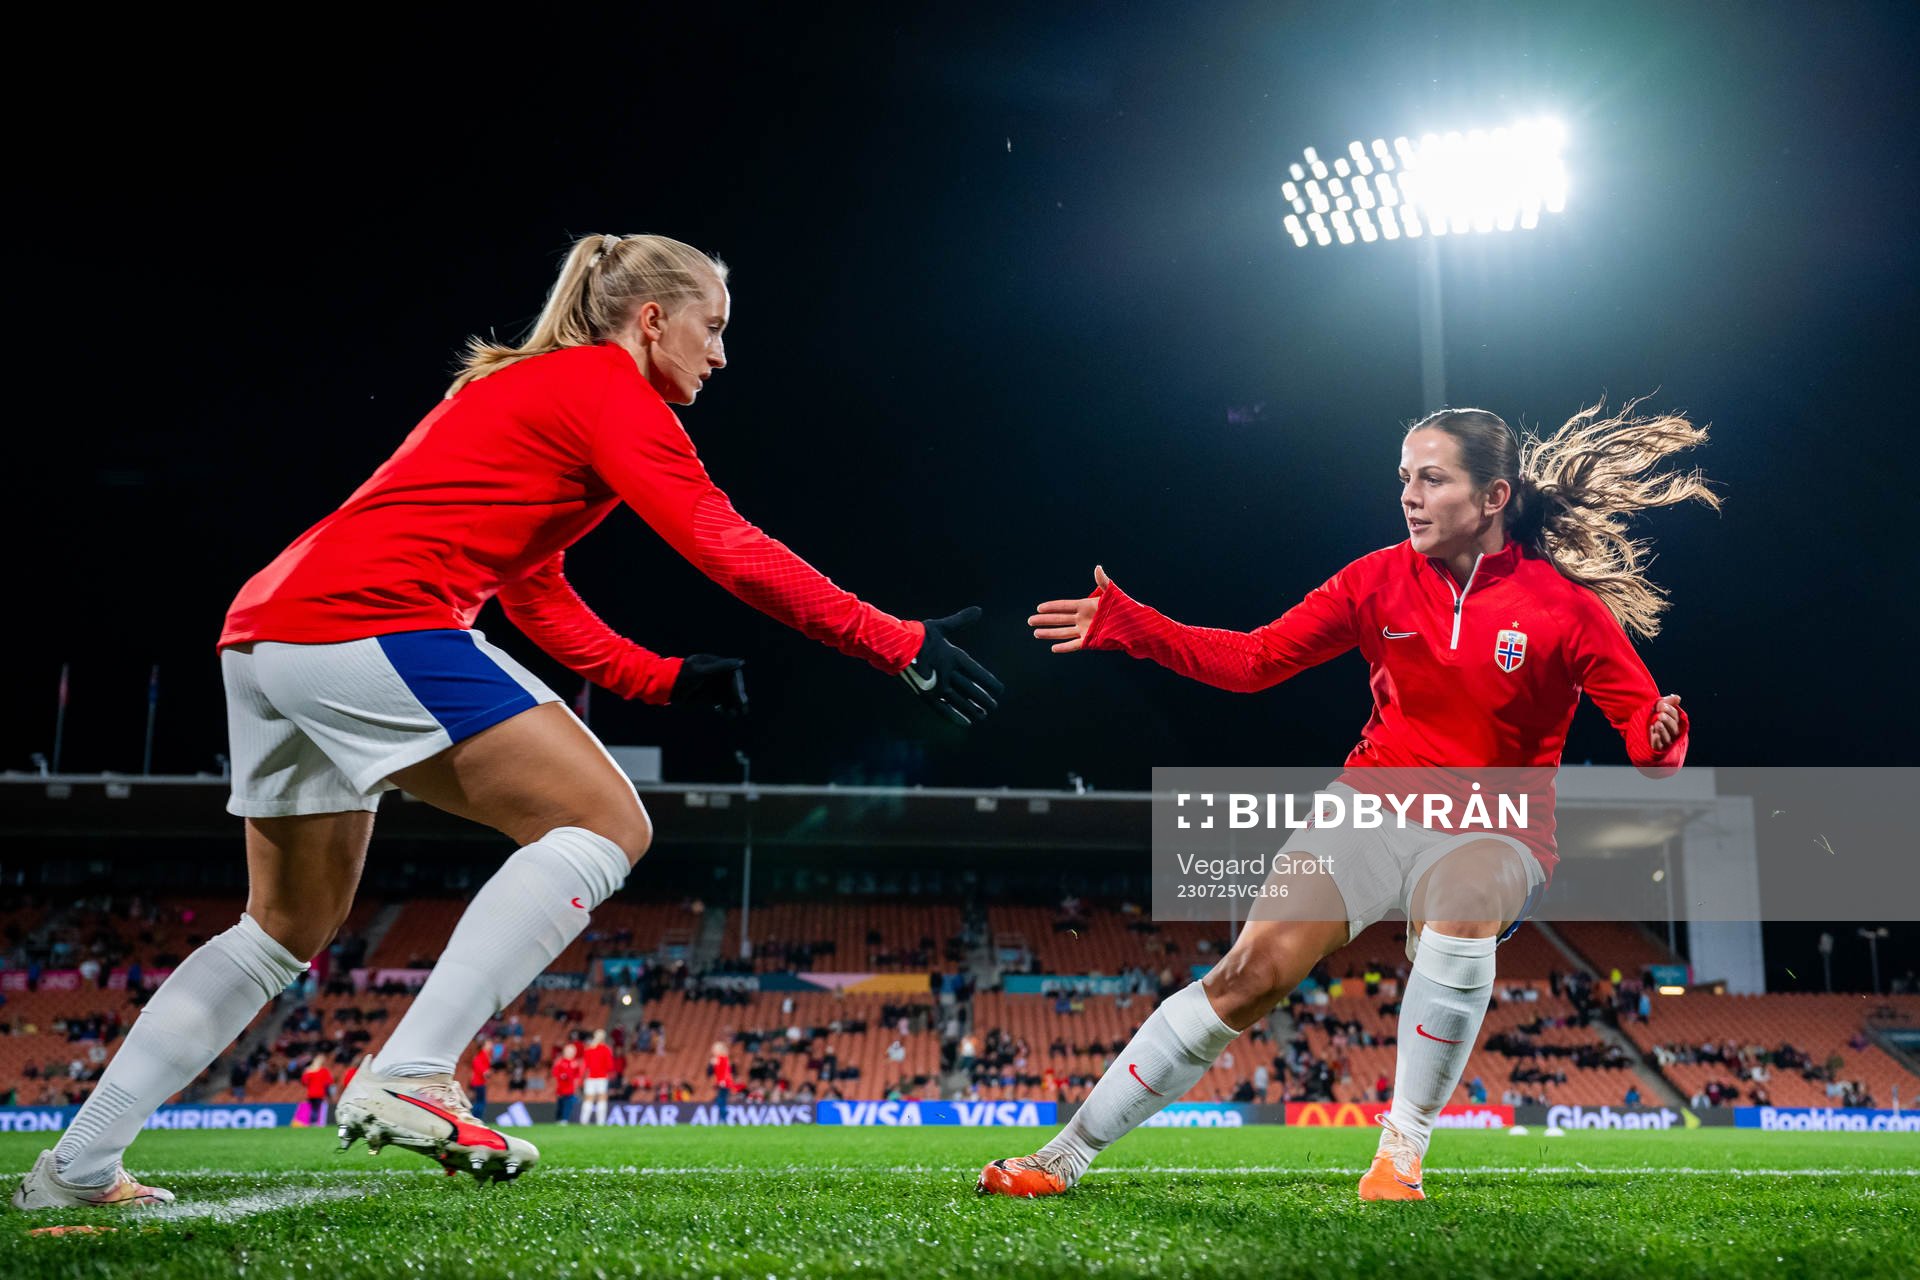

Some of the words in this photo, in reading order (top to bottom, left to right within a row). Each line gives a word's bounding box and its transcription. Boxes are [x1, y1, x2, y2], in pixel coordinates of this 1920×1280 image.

[606, 1104, 680, 1127] ATAR
[832, 1102, 923, 1126] VISA
[951, 1102, 1041, 1126] VISA
[1546, 1104, 1678, 1130] Globant
